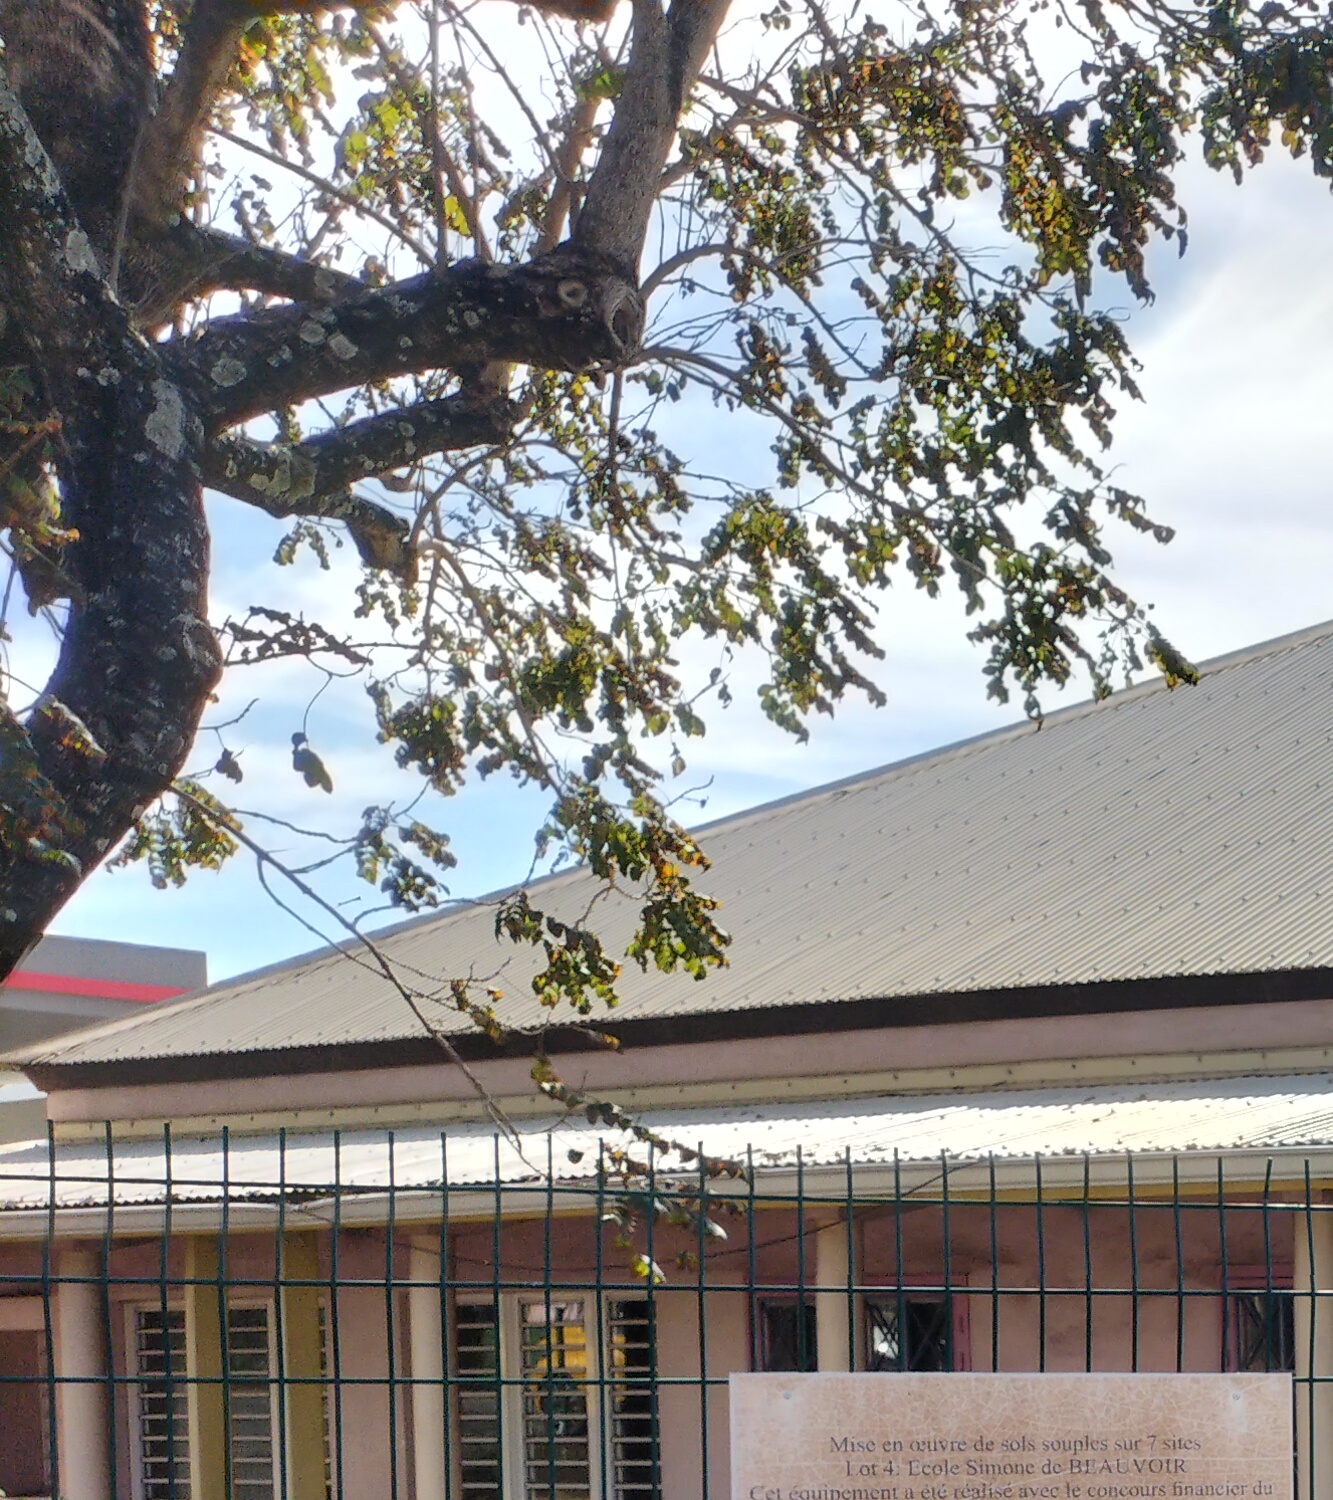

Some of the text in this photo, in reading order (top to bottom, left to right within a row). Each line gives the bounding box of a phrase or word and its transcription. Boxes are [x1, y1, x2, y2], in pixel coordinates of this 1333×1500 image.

[830, 1436, 876, 1452] Mise
[883, 1441, 904, 1452] en
[973, 1436, 994, 1451] de
[1001, 1436, 1035, 1451] sols
[1042, 1435, 1108, 1455] souples
[1114, 1439, 1141, 1450] sur
[1148, 1436, 1155, 1450] 7
[1163, 1435, 1201, 1450] sites
[846, 1461, 878, 1477] Lot
[909, 1460, 959, 1476] Ecole
[966, 1460, 1034, 1476] Simone
[1041, 1459, 1064, 1474] de
[1069, 1458, 1187, 1474] BEAUVOIR
[750, 1485, 782, 1500] Cet
[904, 1487, 914, 1500] a
[921, 1483, 947, 1499] été
[954, 1483, 1012, 1499] réalisé
[1018, 1485, 1059, 1498] avec
[1066, 1483, 1081, 1498] le
[1087, 1484, 1166, 1497] concours
[1173, 1482, 1247, 1497] financier
[1253, 1481, 1273, 1495] du
